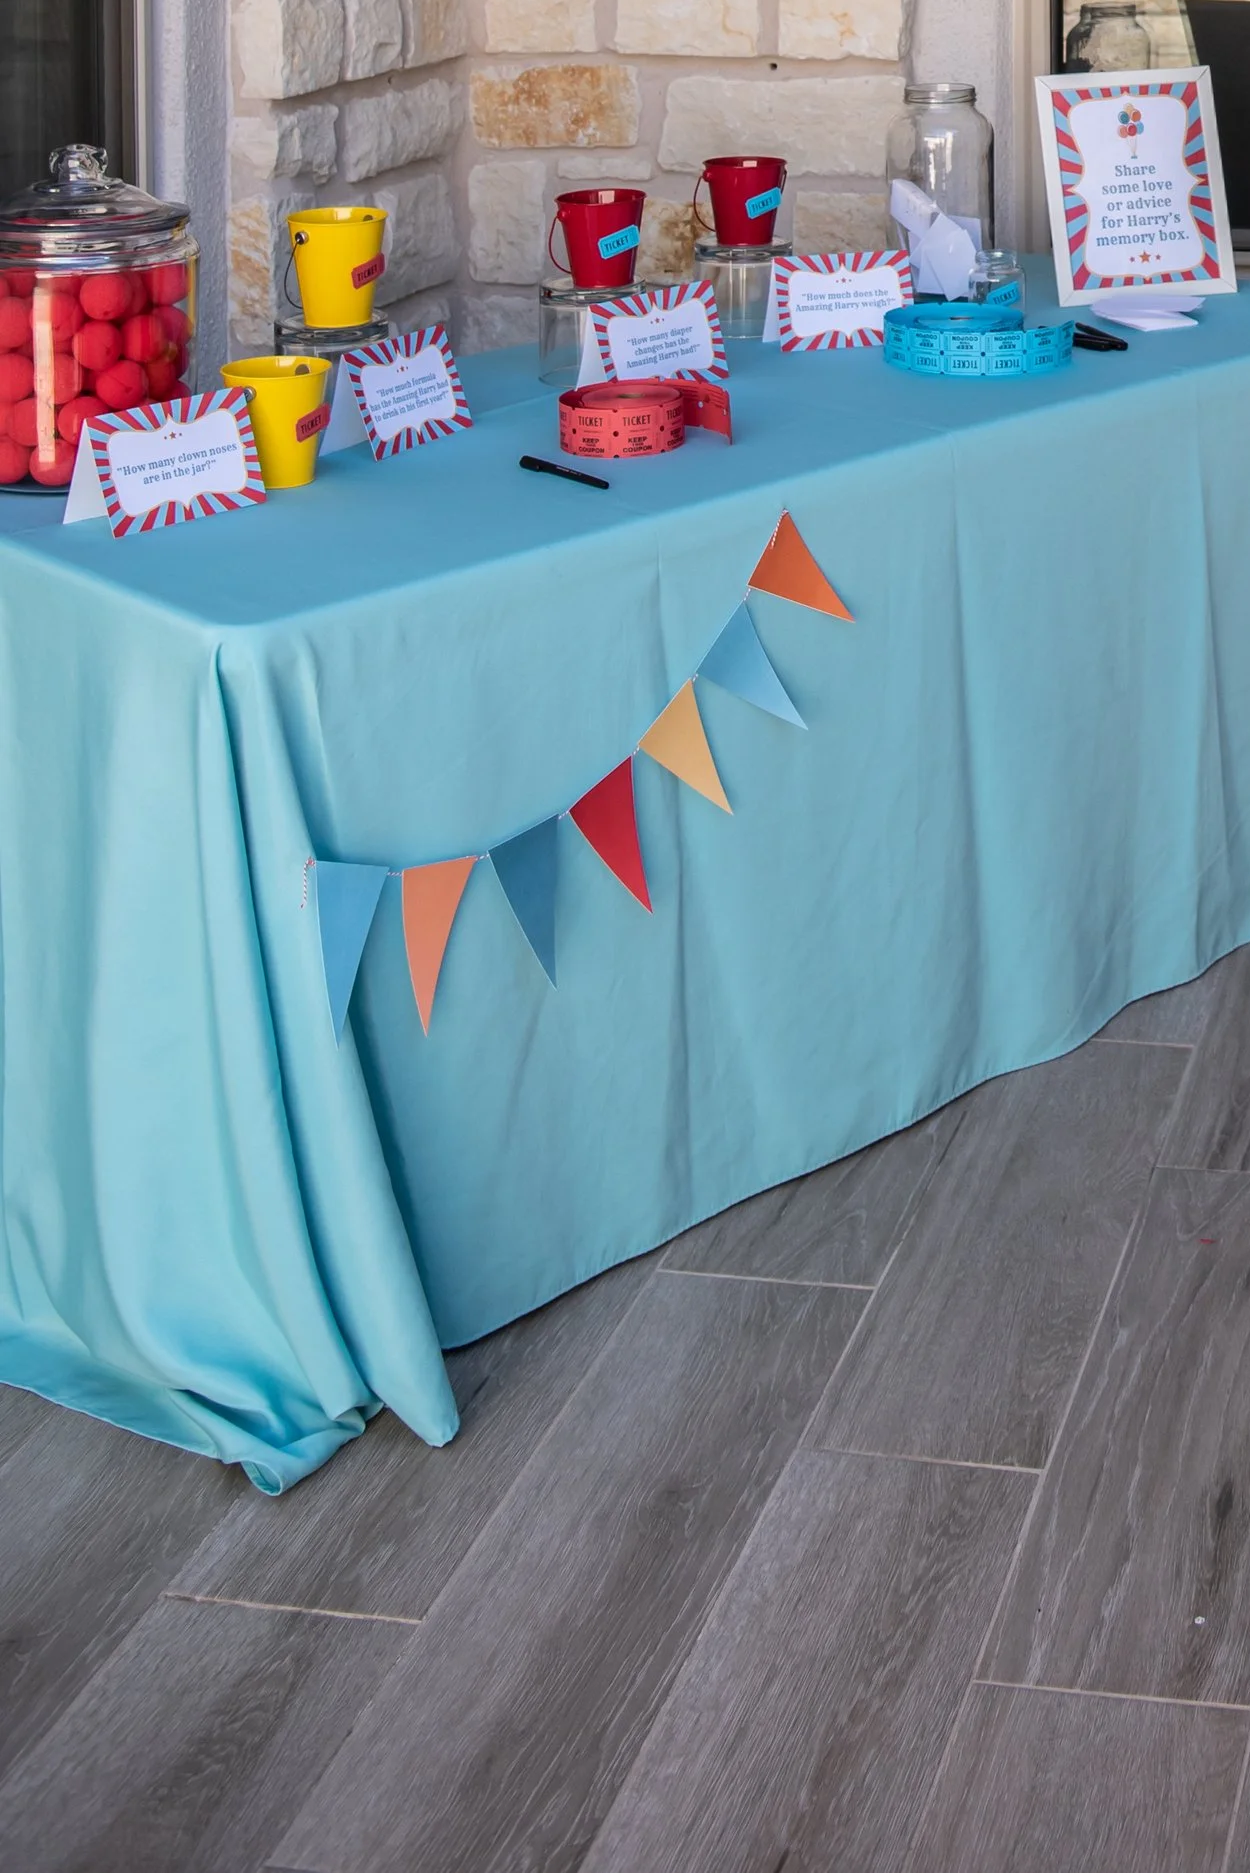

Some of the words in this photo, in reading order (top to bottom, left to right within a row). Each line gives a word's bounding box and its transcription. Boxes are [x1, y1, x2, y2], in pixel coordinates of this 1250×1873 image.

[1114, 164, 1156, 177] Share
[1102, 183, 1140, 195] some
[1142, 180, 1173, 192] love
[1107, 200, 1123, 212] or
[1126, 195, 1172, 210] advice
[1101, 216, 1124, 229] for
[1127, 212, 1181, 227] Harry's
[604, 235, 628, 251] TICKET
[1096, 232, 1155, 247] memory
[1159, 229, 1190, 242] box.
[828, 291, 851, 300] much
[853, 289, 873, 298] does
[874, 288, 889, 296] the
[795, 303, 833, 312] Amazing
[834, 301, 860, 310] Harry
[649, 331, 669, 342] many
[670, 326, 693, 338] diaper
[635, 344, 664, 357] changes
[665, 340, 678, 349] has
[678, 336, 690, 346] the
[627, 356, 658, 368] Amazing
[658, 350, 679, 362] Harry
[916, 356, 938, 367] TICKET
[952, 359, 978, 369] TICKET
[994, 359, 1020, 369] TICKET
[395, 381, 412, 392] much
[411, 372, 436, 386] formula
[369, 403, 381, 413] has
[381, 398, 392, 408] the
[392, 390, 419, 405] Amazing
[419, 384, 436, 397] Harry
[436, 379, 449, 390] had
[374, 414, 382, 423] to
[382, 408, 399, 420] drink
[399, 405, 406, 414] in
[406, 401, 416, 412] his
[416, 397, 429, 408] first
[301, 414, 321, 434] TICKET
[578, 415, 604, 427] TICKET
[622, 414, 652, 427] TICKET
[578, 446, 605, 454] COUPON
[622, 444, 653, 453] COUPON
[116, 464, 147, 476] "How
[149, 456, 176, 470] many
[177, 449, 208, 463] clown
[209, 443, 238, 456] noses
[143, 474, 160, 485] are
[161, 470, 172, 481] in
[173, 466, 191, 478] the
